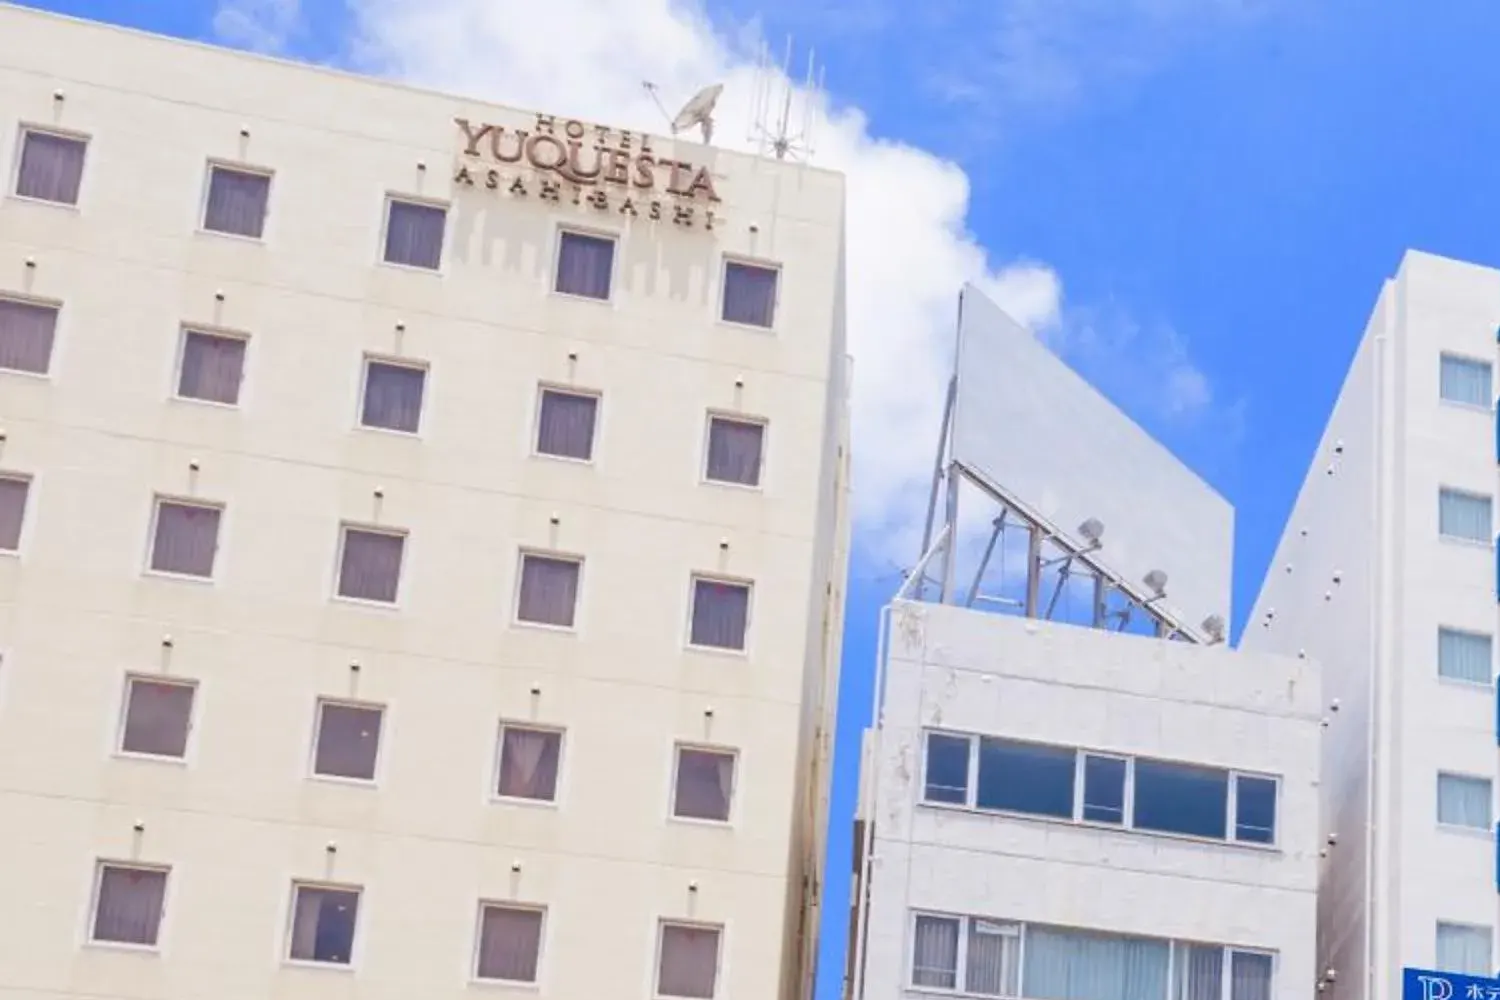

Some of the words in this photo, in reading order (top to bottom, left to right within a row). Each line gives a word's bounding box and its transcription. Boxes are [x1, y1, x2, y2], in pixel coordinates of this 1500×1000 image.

[454, 117, 722, 203] YUQUESTA
[534, 112, 653, 152] HOTEL
[454, 167, 716, 232] ASAHIBASHI
